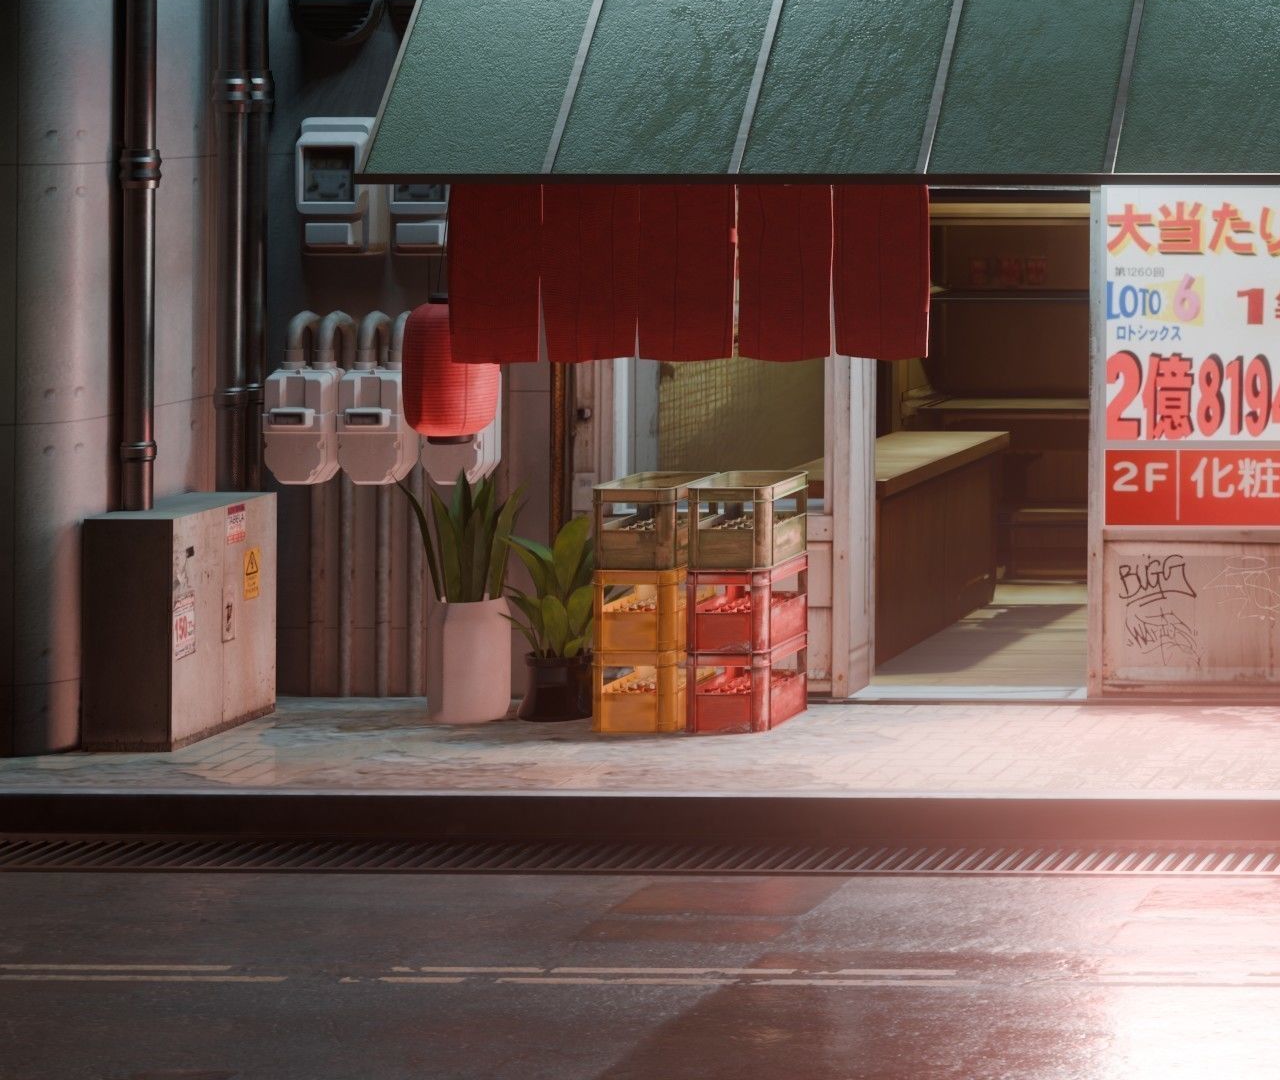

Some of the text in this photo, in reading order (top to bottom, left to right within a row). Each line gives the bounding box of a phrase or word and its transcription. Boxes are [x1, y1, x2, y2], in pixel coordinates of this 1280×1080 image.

[1106, 273, 1201, 322] LOTO 6
[1115, 325, 1182, 342] ロトシックス
[1112, 462, 1169, 493] 2F
